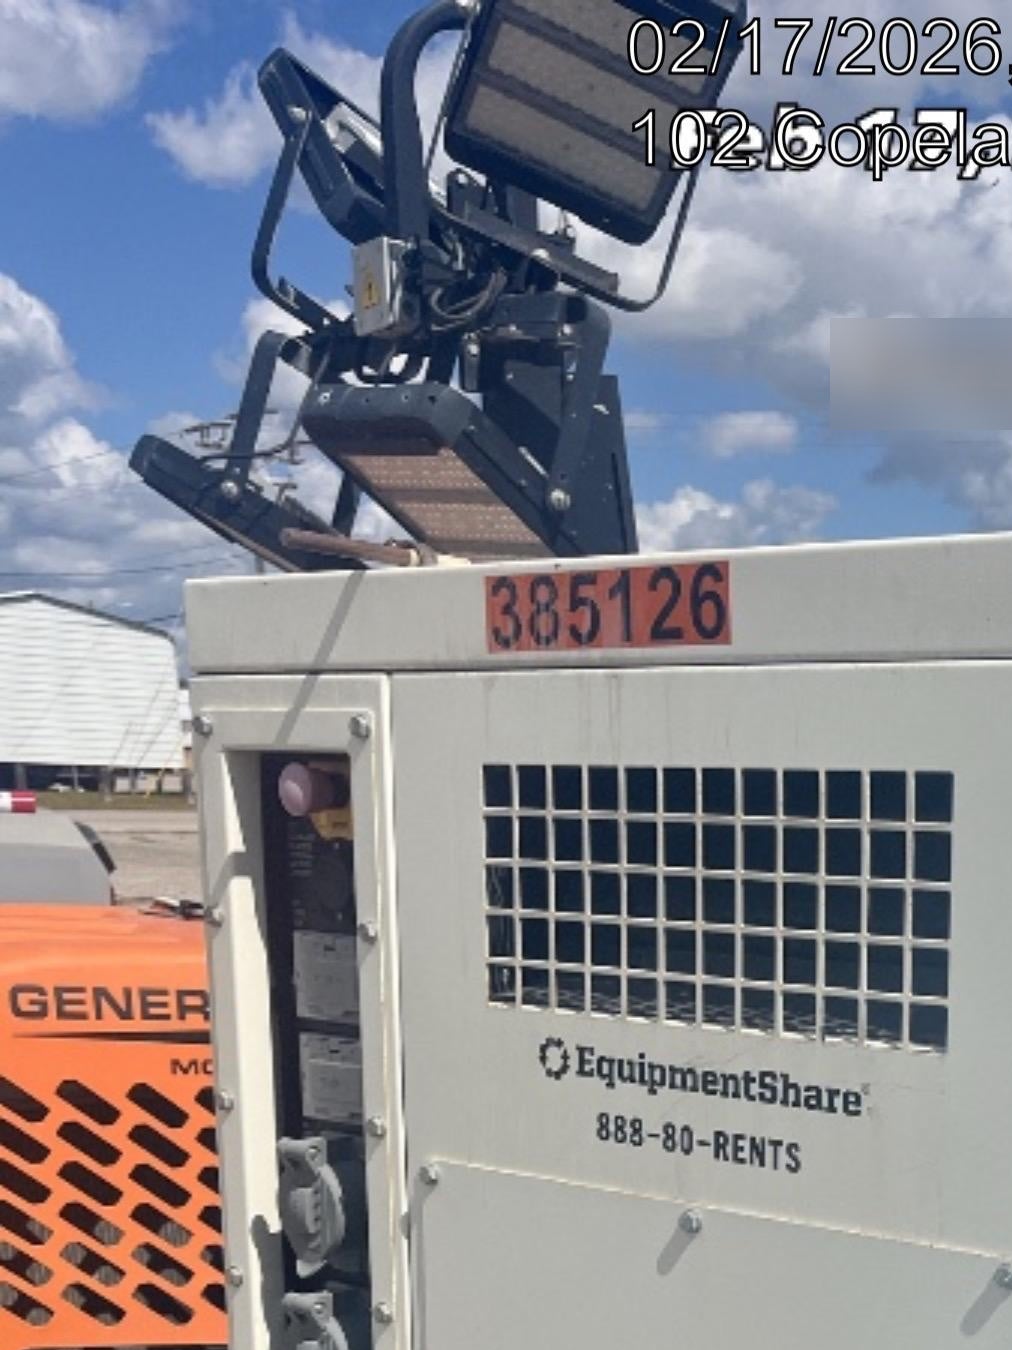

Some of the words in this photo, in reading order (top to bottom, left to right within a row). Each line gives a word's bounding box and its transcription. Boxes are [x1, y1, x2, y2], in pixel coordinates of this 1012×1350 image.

[490, 562, 728, 649] 385126
[575, 1045, 864, 1117] EquipmentShare
[596, 1112, 802, 1174] 888-80-RENTS
